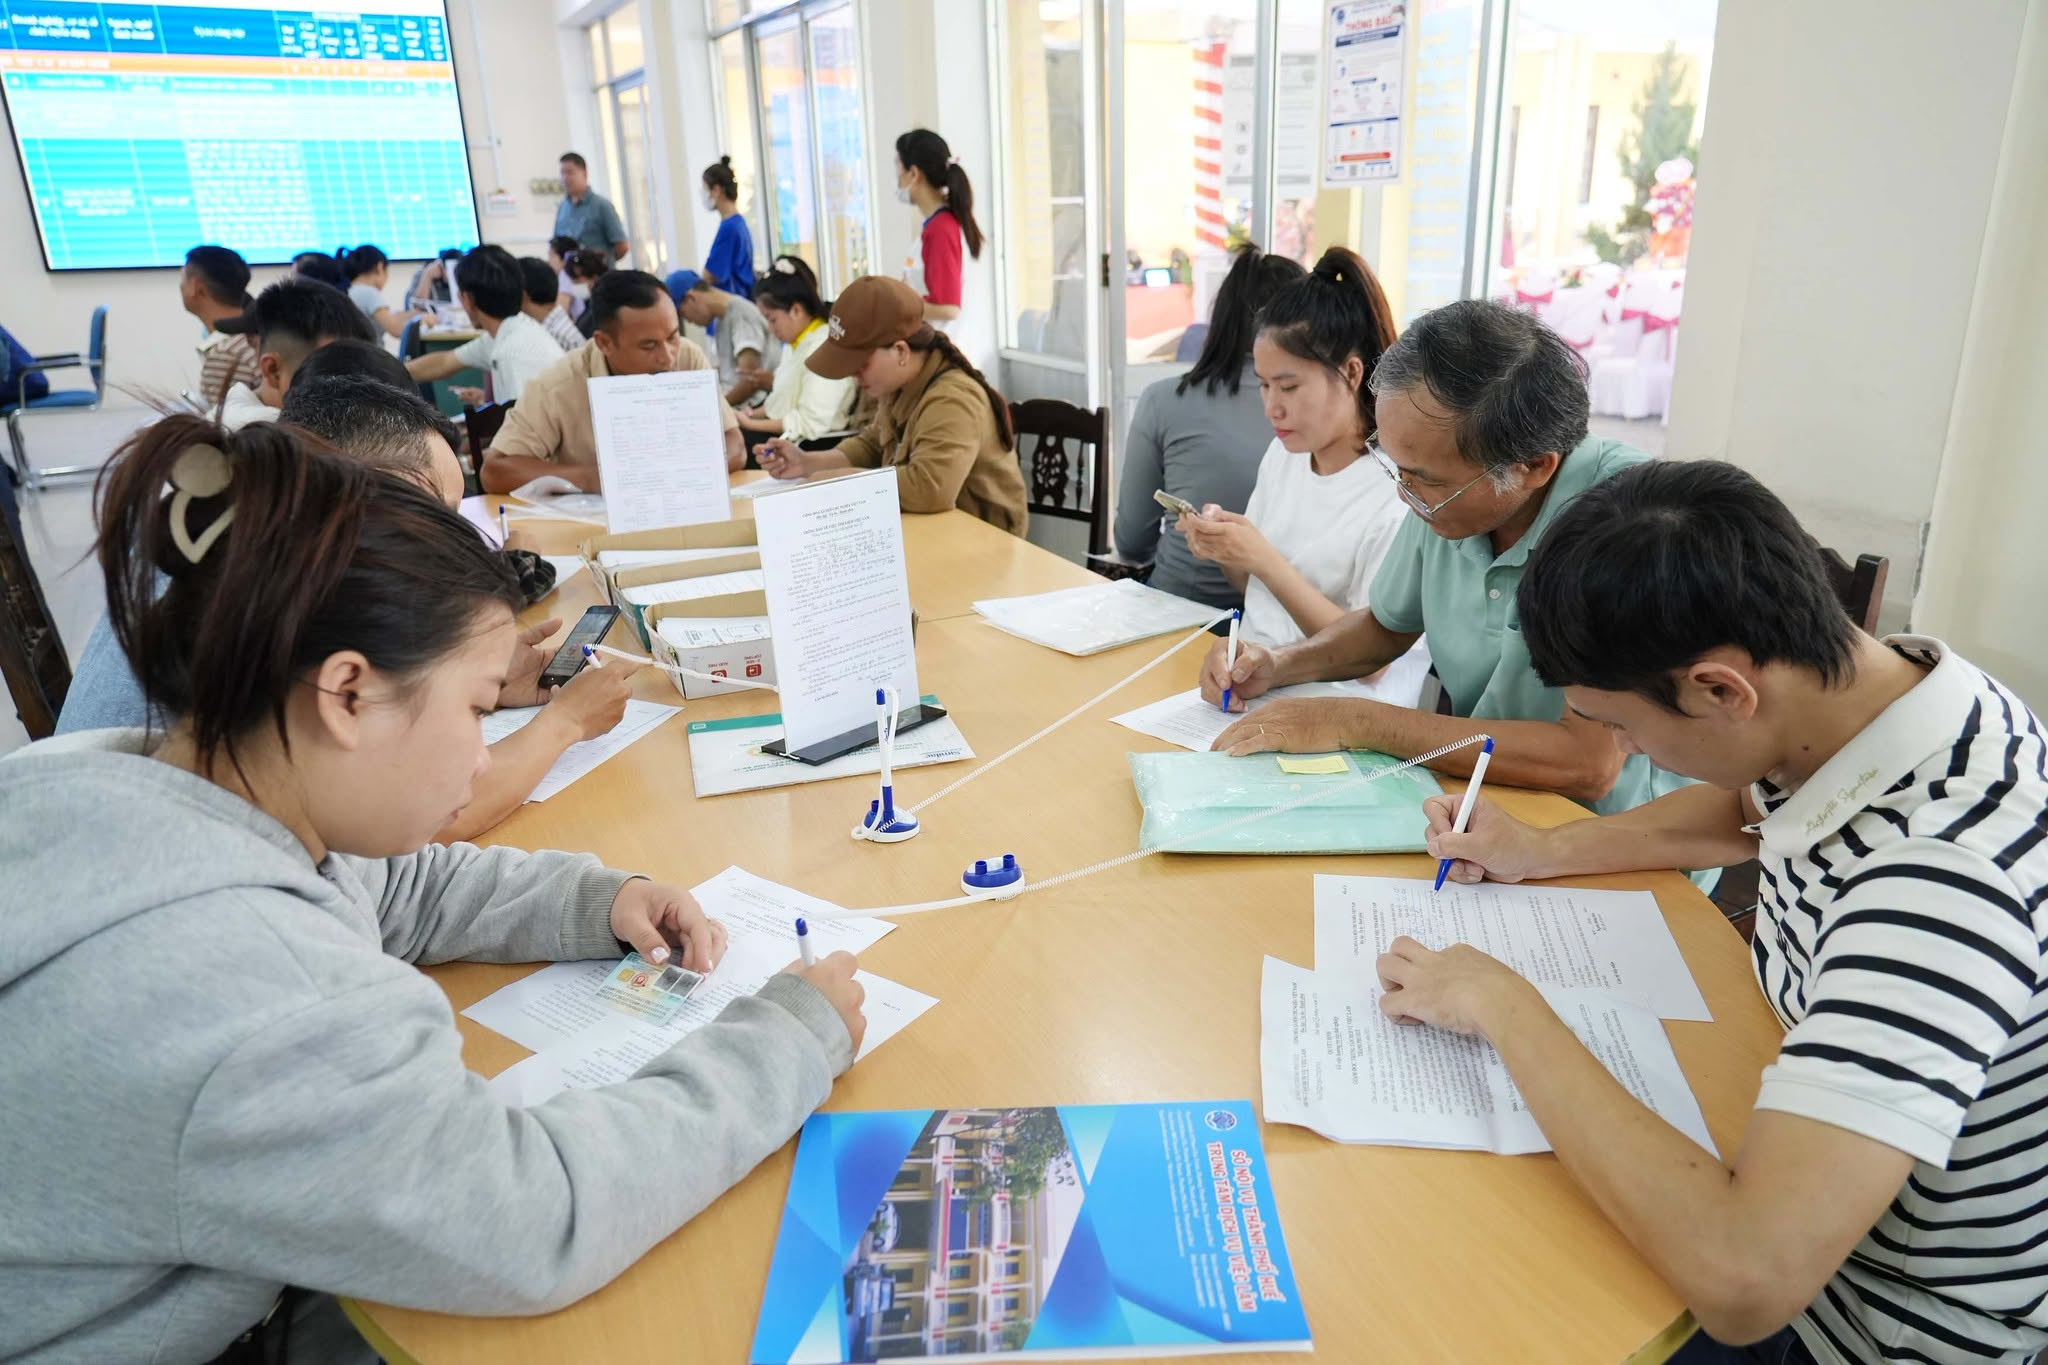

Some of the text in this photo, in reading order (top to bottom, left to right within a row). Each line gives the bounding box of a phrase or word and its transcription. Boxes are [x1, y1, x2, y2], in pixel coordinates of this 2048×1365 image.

[1207, 1141, 1227, 1178] TRUNG
[1214, 1178, 1234, 1205] TÂM
[1217, 1205, 1239, 1235] DỊCH
[1231, 1150, 1286, 1302] SỞ NỘI VỤ THÀNH PHỐ HUẾ
[1223, 1235, 1243, 1255] VỤ
[1228, 1254, 1252, 1285] VIỆC
[1234, 1284, 1258, 1312] LÀM
